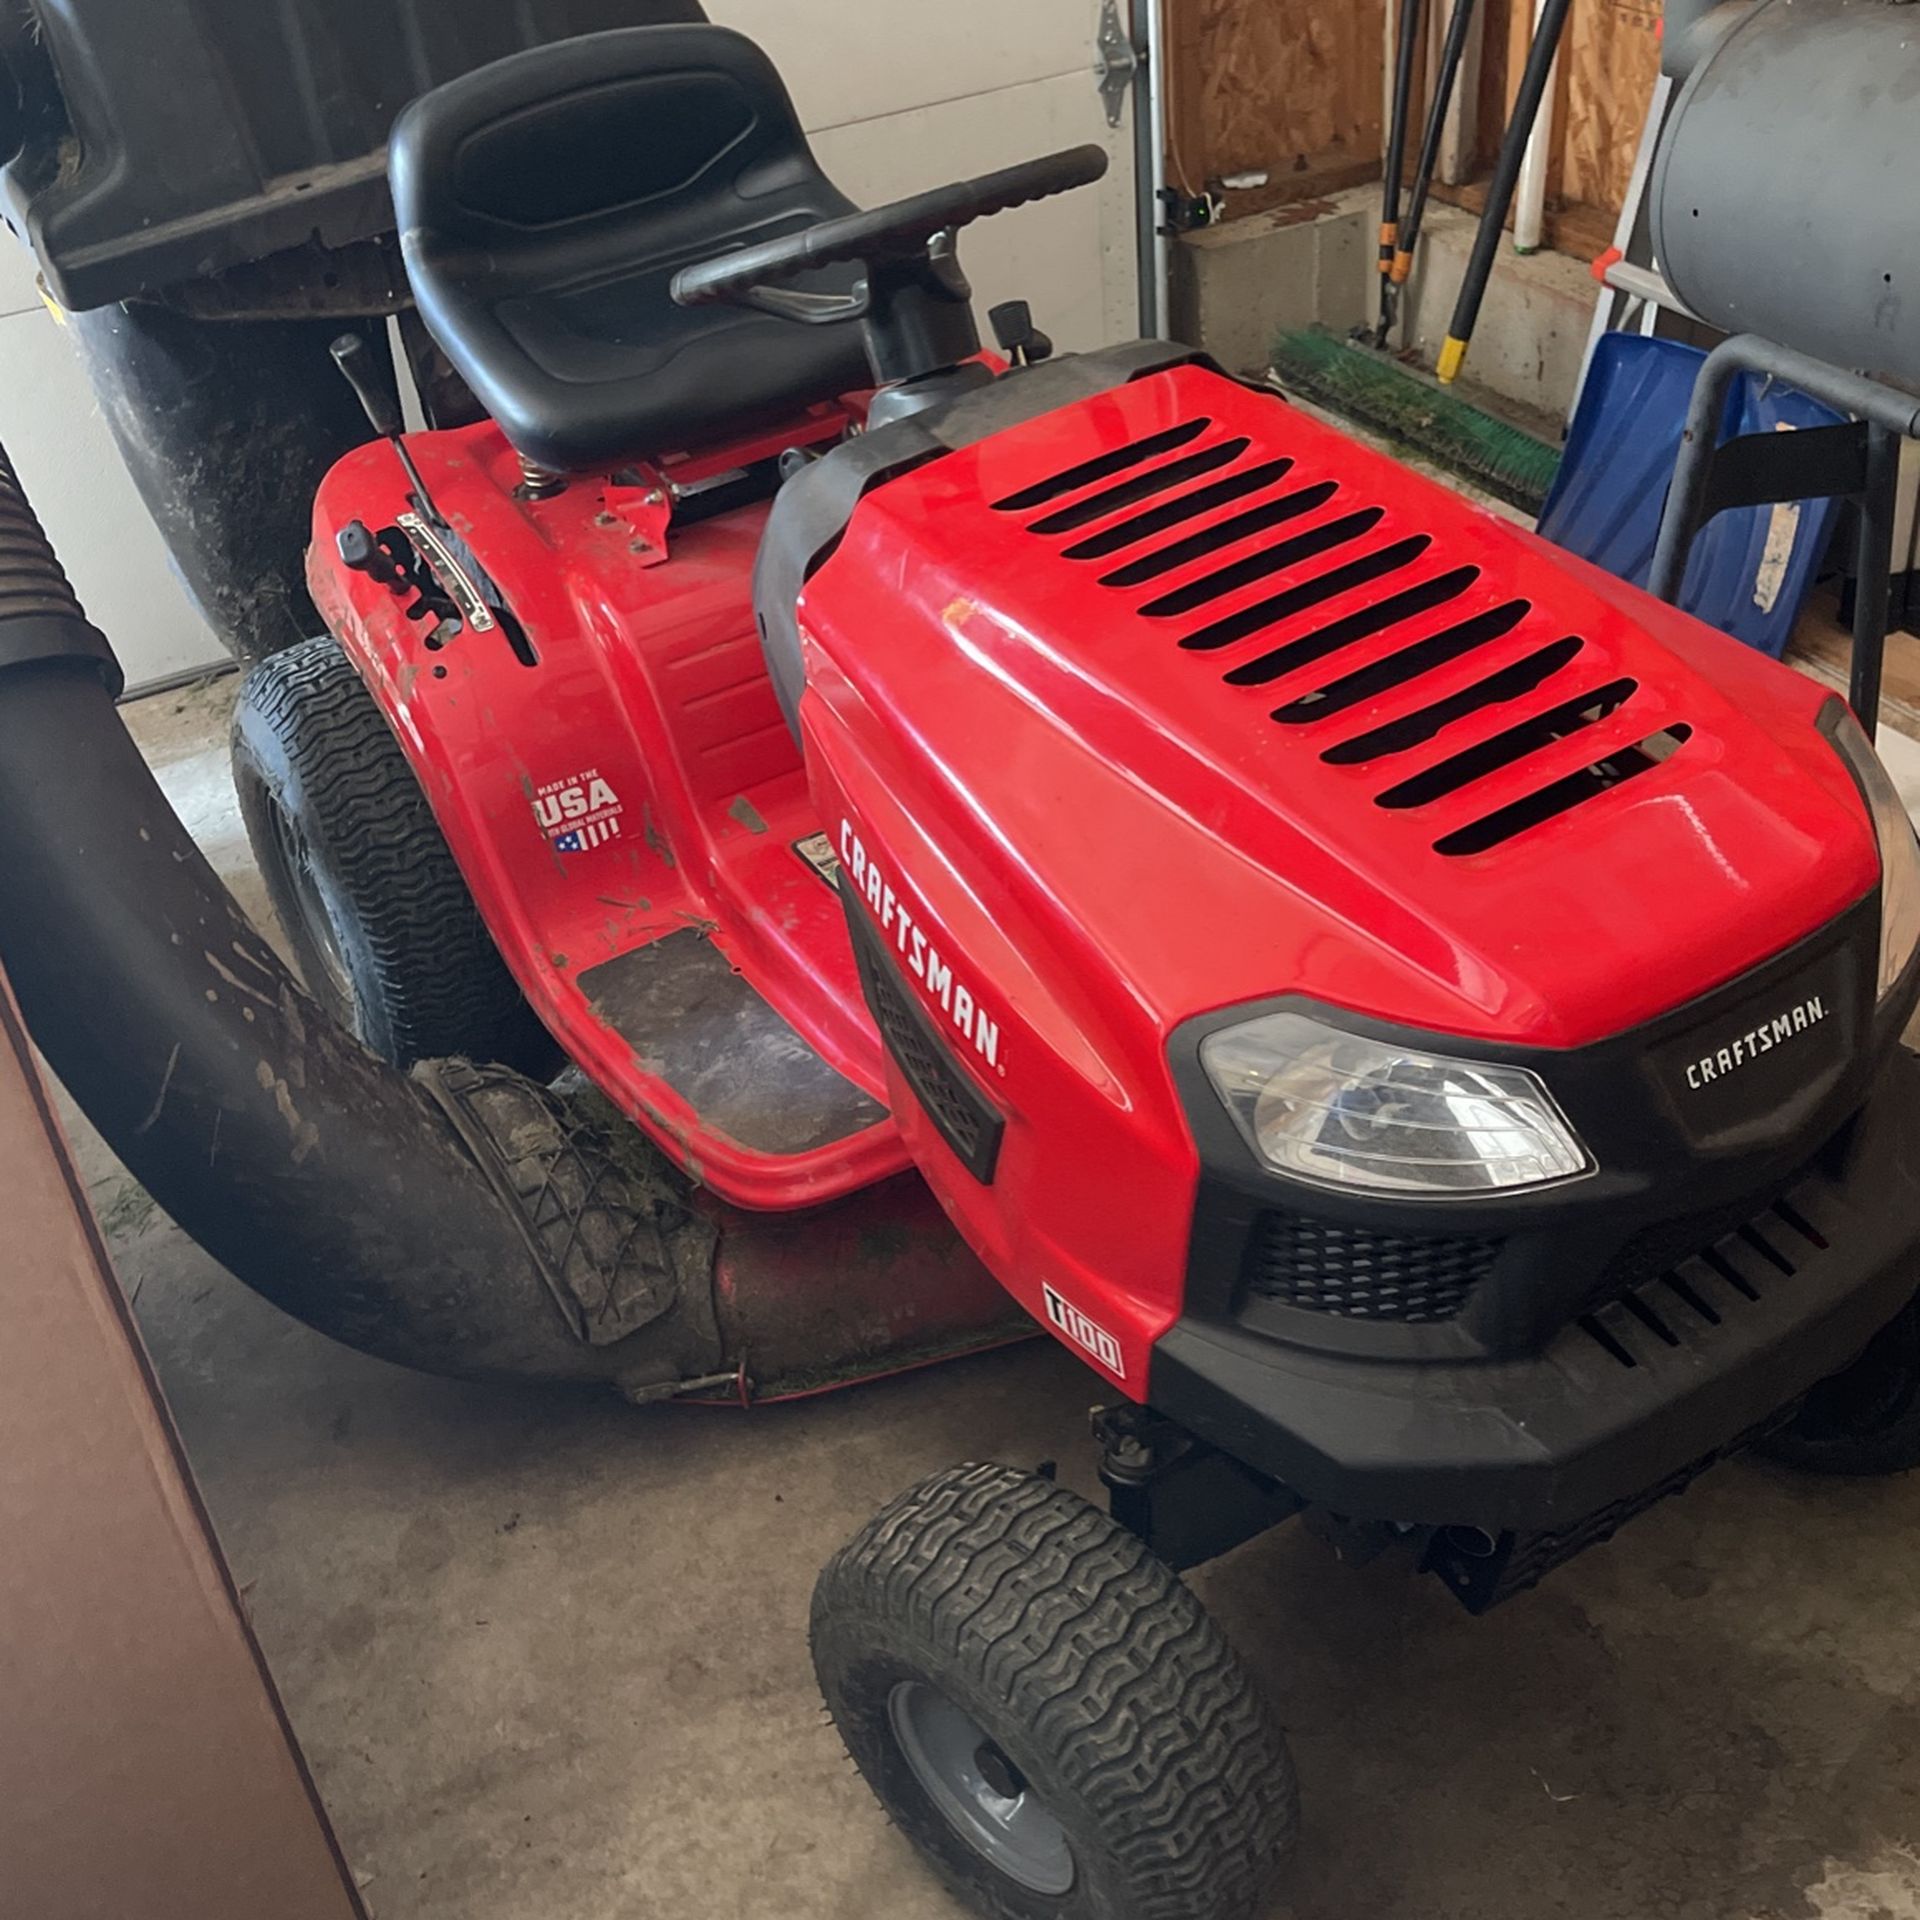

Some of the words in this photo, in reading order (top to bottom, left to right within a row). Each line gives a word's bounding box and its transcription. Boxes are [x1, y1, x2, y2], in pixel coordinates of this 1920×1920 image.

[531, 778, 619, 828] USA
[537, 781, 564, 796] MADE
[567, 776, 578, 786] IN
[580, 768, 598, 781] THE
[560, 818, 586, 833] GLOBAL
[585, 804, 623, 824] MATERIALS
[841, 818, 999, 1068] CRAFTSMAN
[1686, 996, 1824, 1089] CRAFTSMAN
[1044, 1286, 1119, 1371] T100
